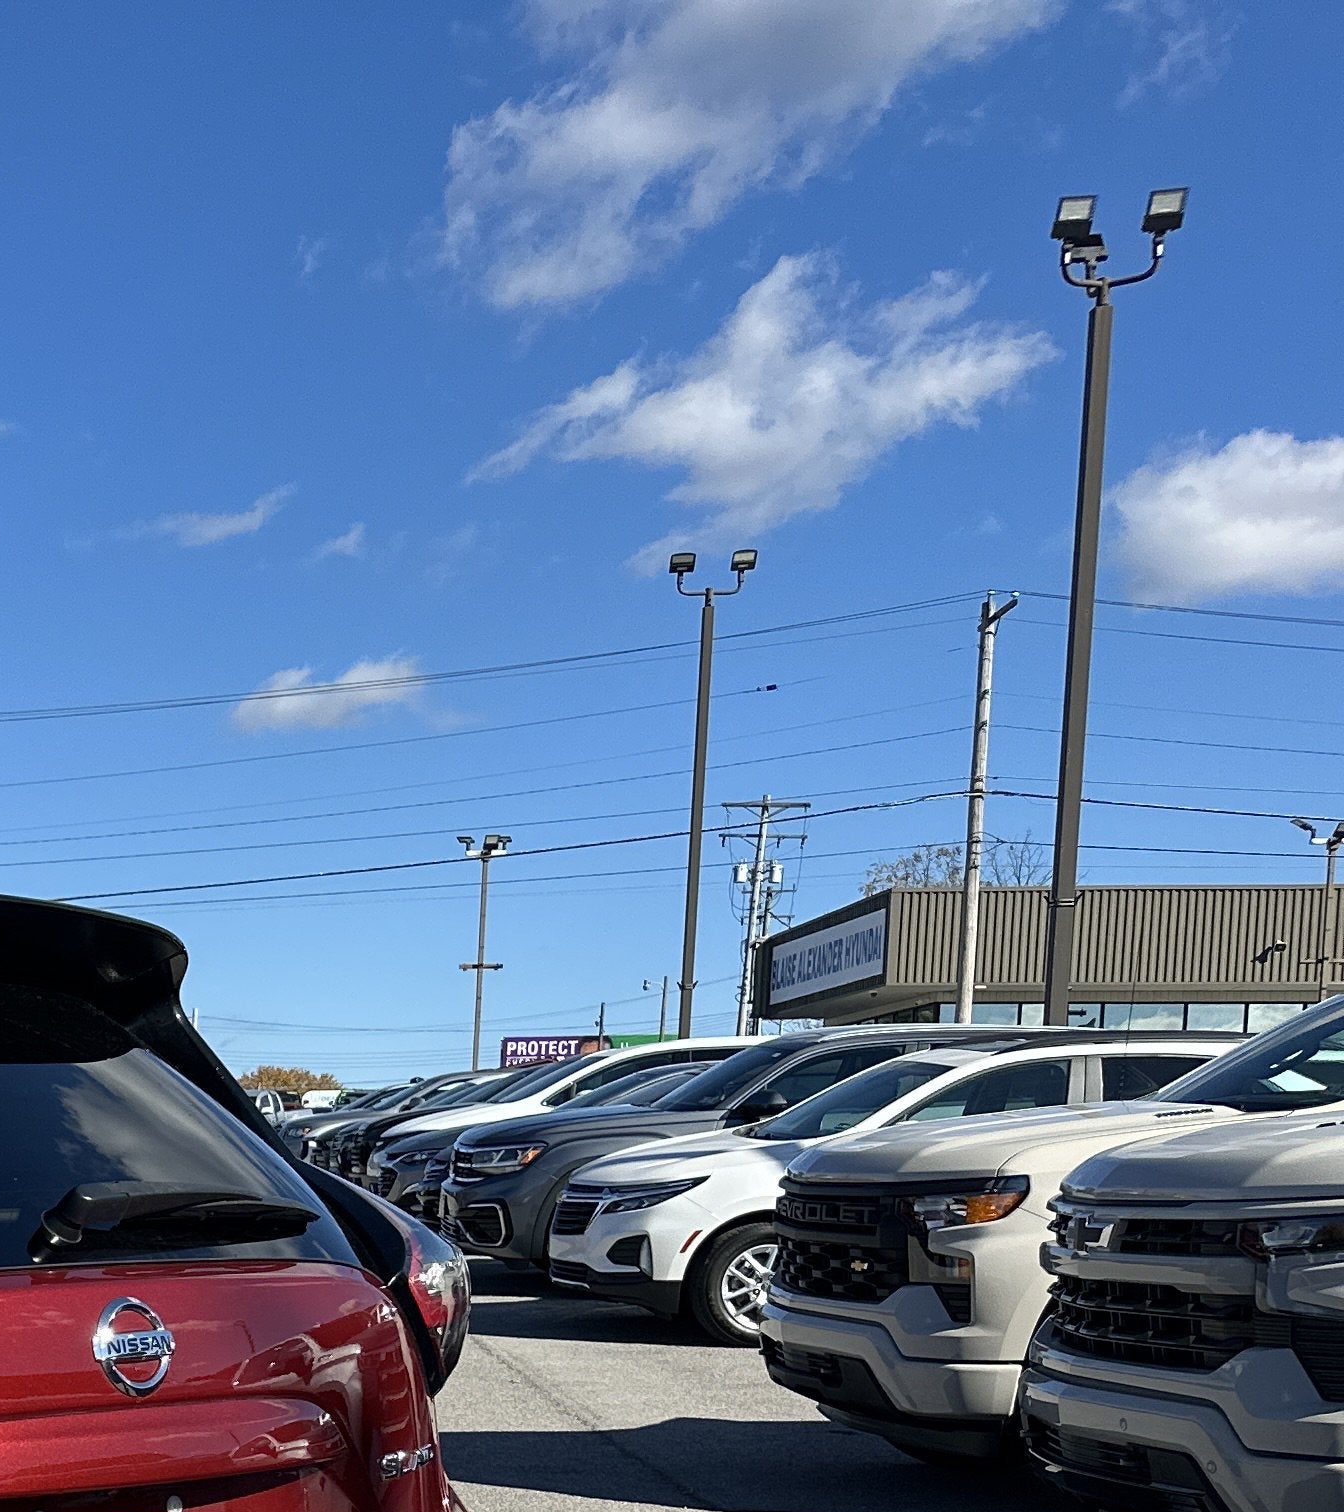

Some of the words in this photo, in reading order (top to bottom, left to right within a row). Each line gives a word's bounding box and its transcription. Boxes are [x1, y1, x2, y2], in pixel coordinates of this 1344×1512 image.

[772, 953, 797, 991] BLAISE
[797, 938, 843, 982] ALEXANDER
[844, 925, 882, 970] HYUNDAI
[506, 1040, 578, 1055] PROTECT
[107, 1335, 172, 1355] NISSAN
